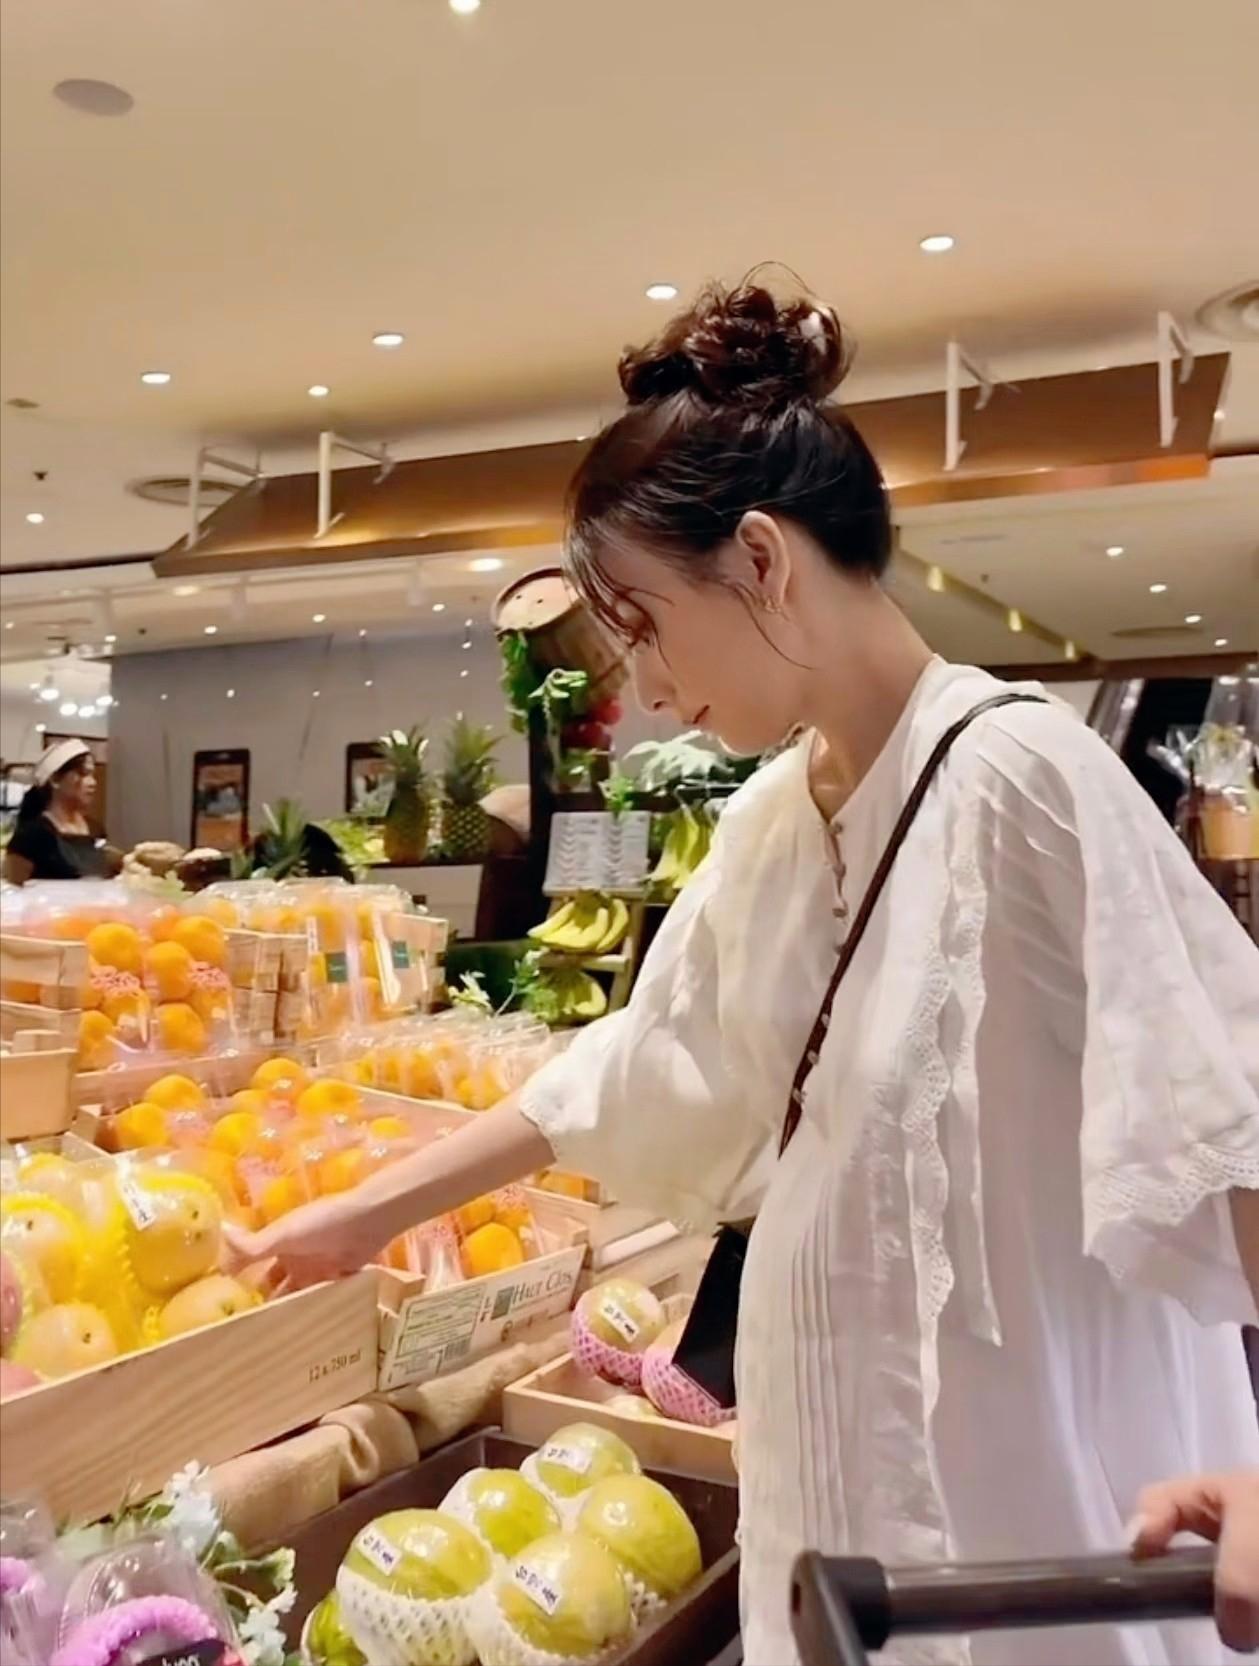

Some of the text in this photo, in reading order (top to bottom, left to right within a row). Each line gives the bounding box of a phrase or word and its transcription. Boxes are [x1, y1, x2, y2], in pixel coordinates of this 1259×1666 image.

[308, 1365, 320, 1384] 12
[331, 1354, 347, 1373] 750
[349, 1349, 361, 1366] ml
